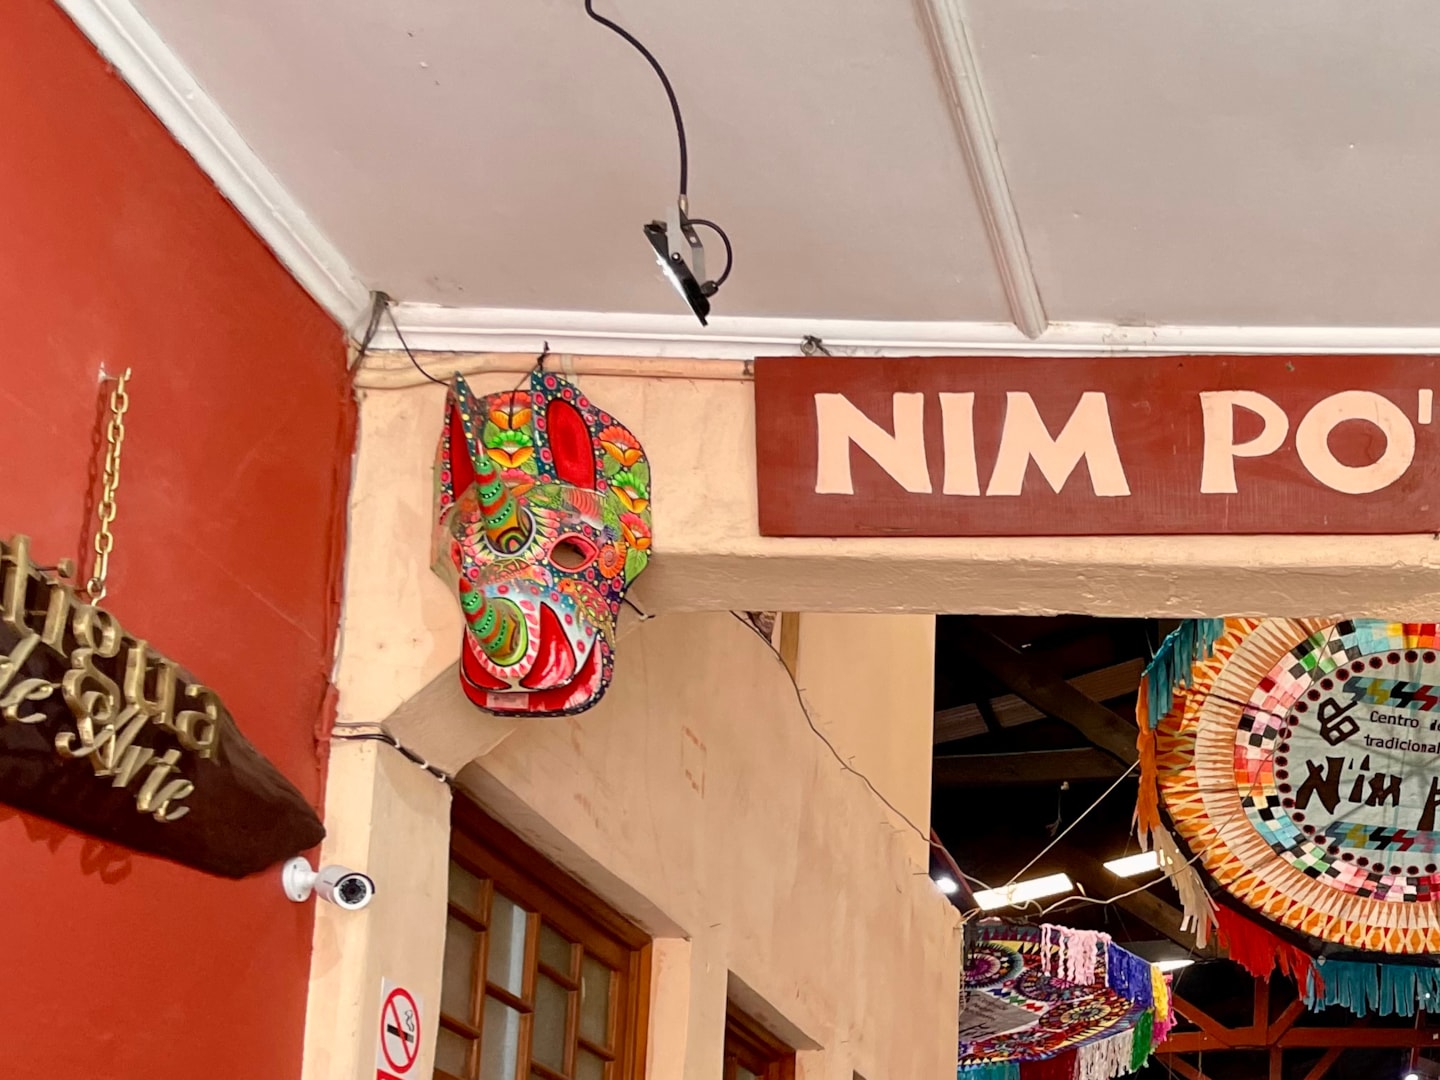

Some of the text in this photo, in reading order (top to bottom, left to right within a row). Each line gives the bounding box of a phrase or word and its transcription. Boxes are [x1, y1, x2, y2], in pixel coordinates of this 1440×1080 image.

[813, 391, 1132, 497] NIM
[0, 534, 221, 760] tigua
[1370, 709, 1419, 730] Centro
[1294, 754, 1403, 815] Nim
